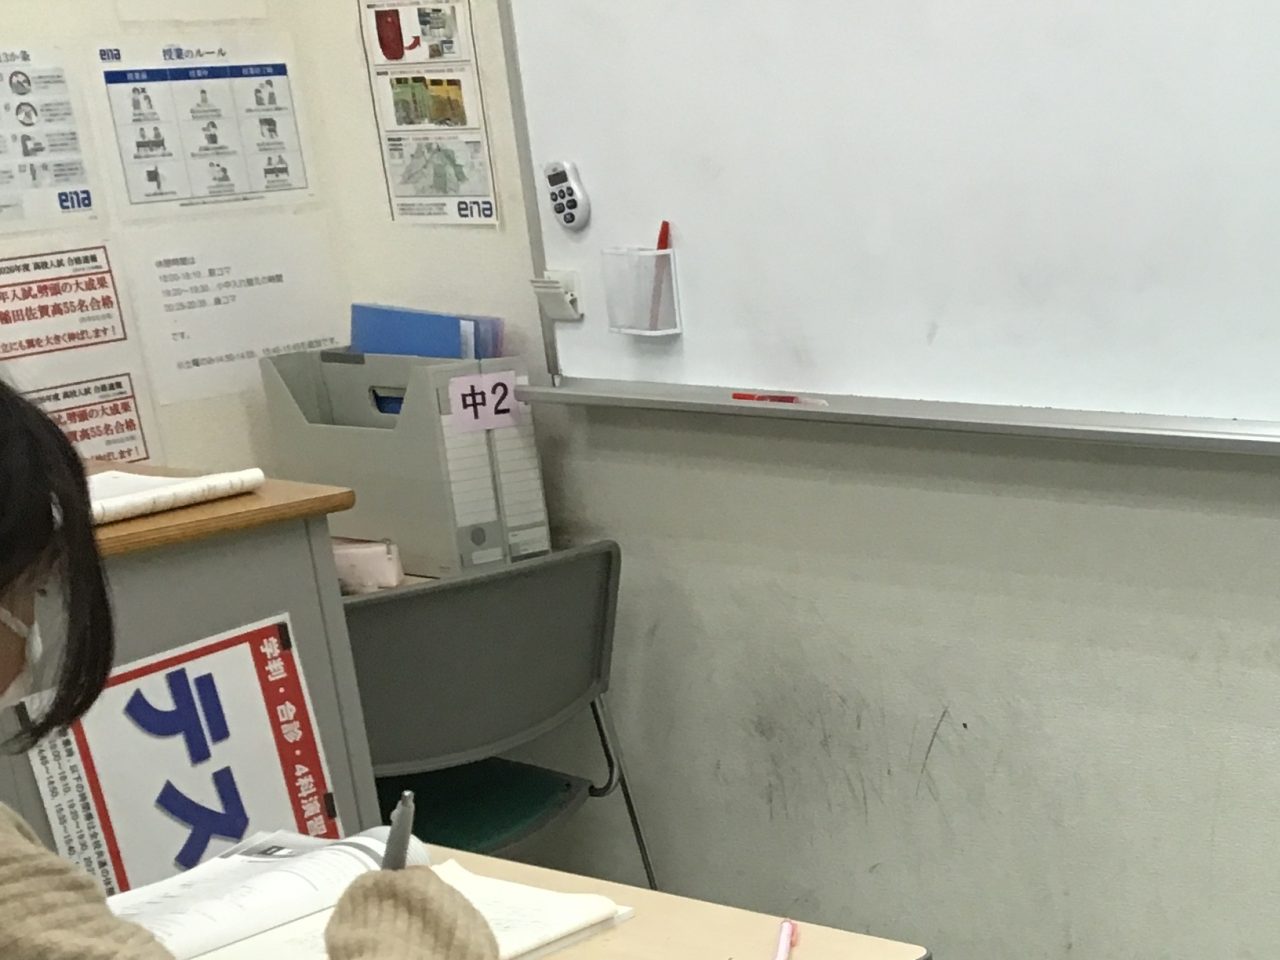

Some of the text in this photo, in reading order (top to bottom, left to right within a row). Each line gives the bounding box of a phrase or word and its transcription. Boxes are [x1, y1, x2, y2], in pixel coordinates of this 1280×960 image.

[99, 48, 121, 61] ena
[162, 47, 227, 61] 授業のルール
[58, 189, 92, 210] ena
[457, 200, 494, 218] ena
[461, 382, 511, 420] 中2
[123, 667, 249, 872] テス
